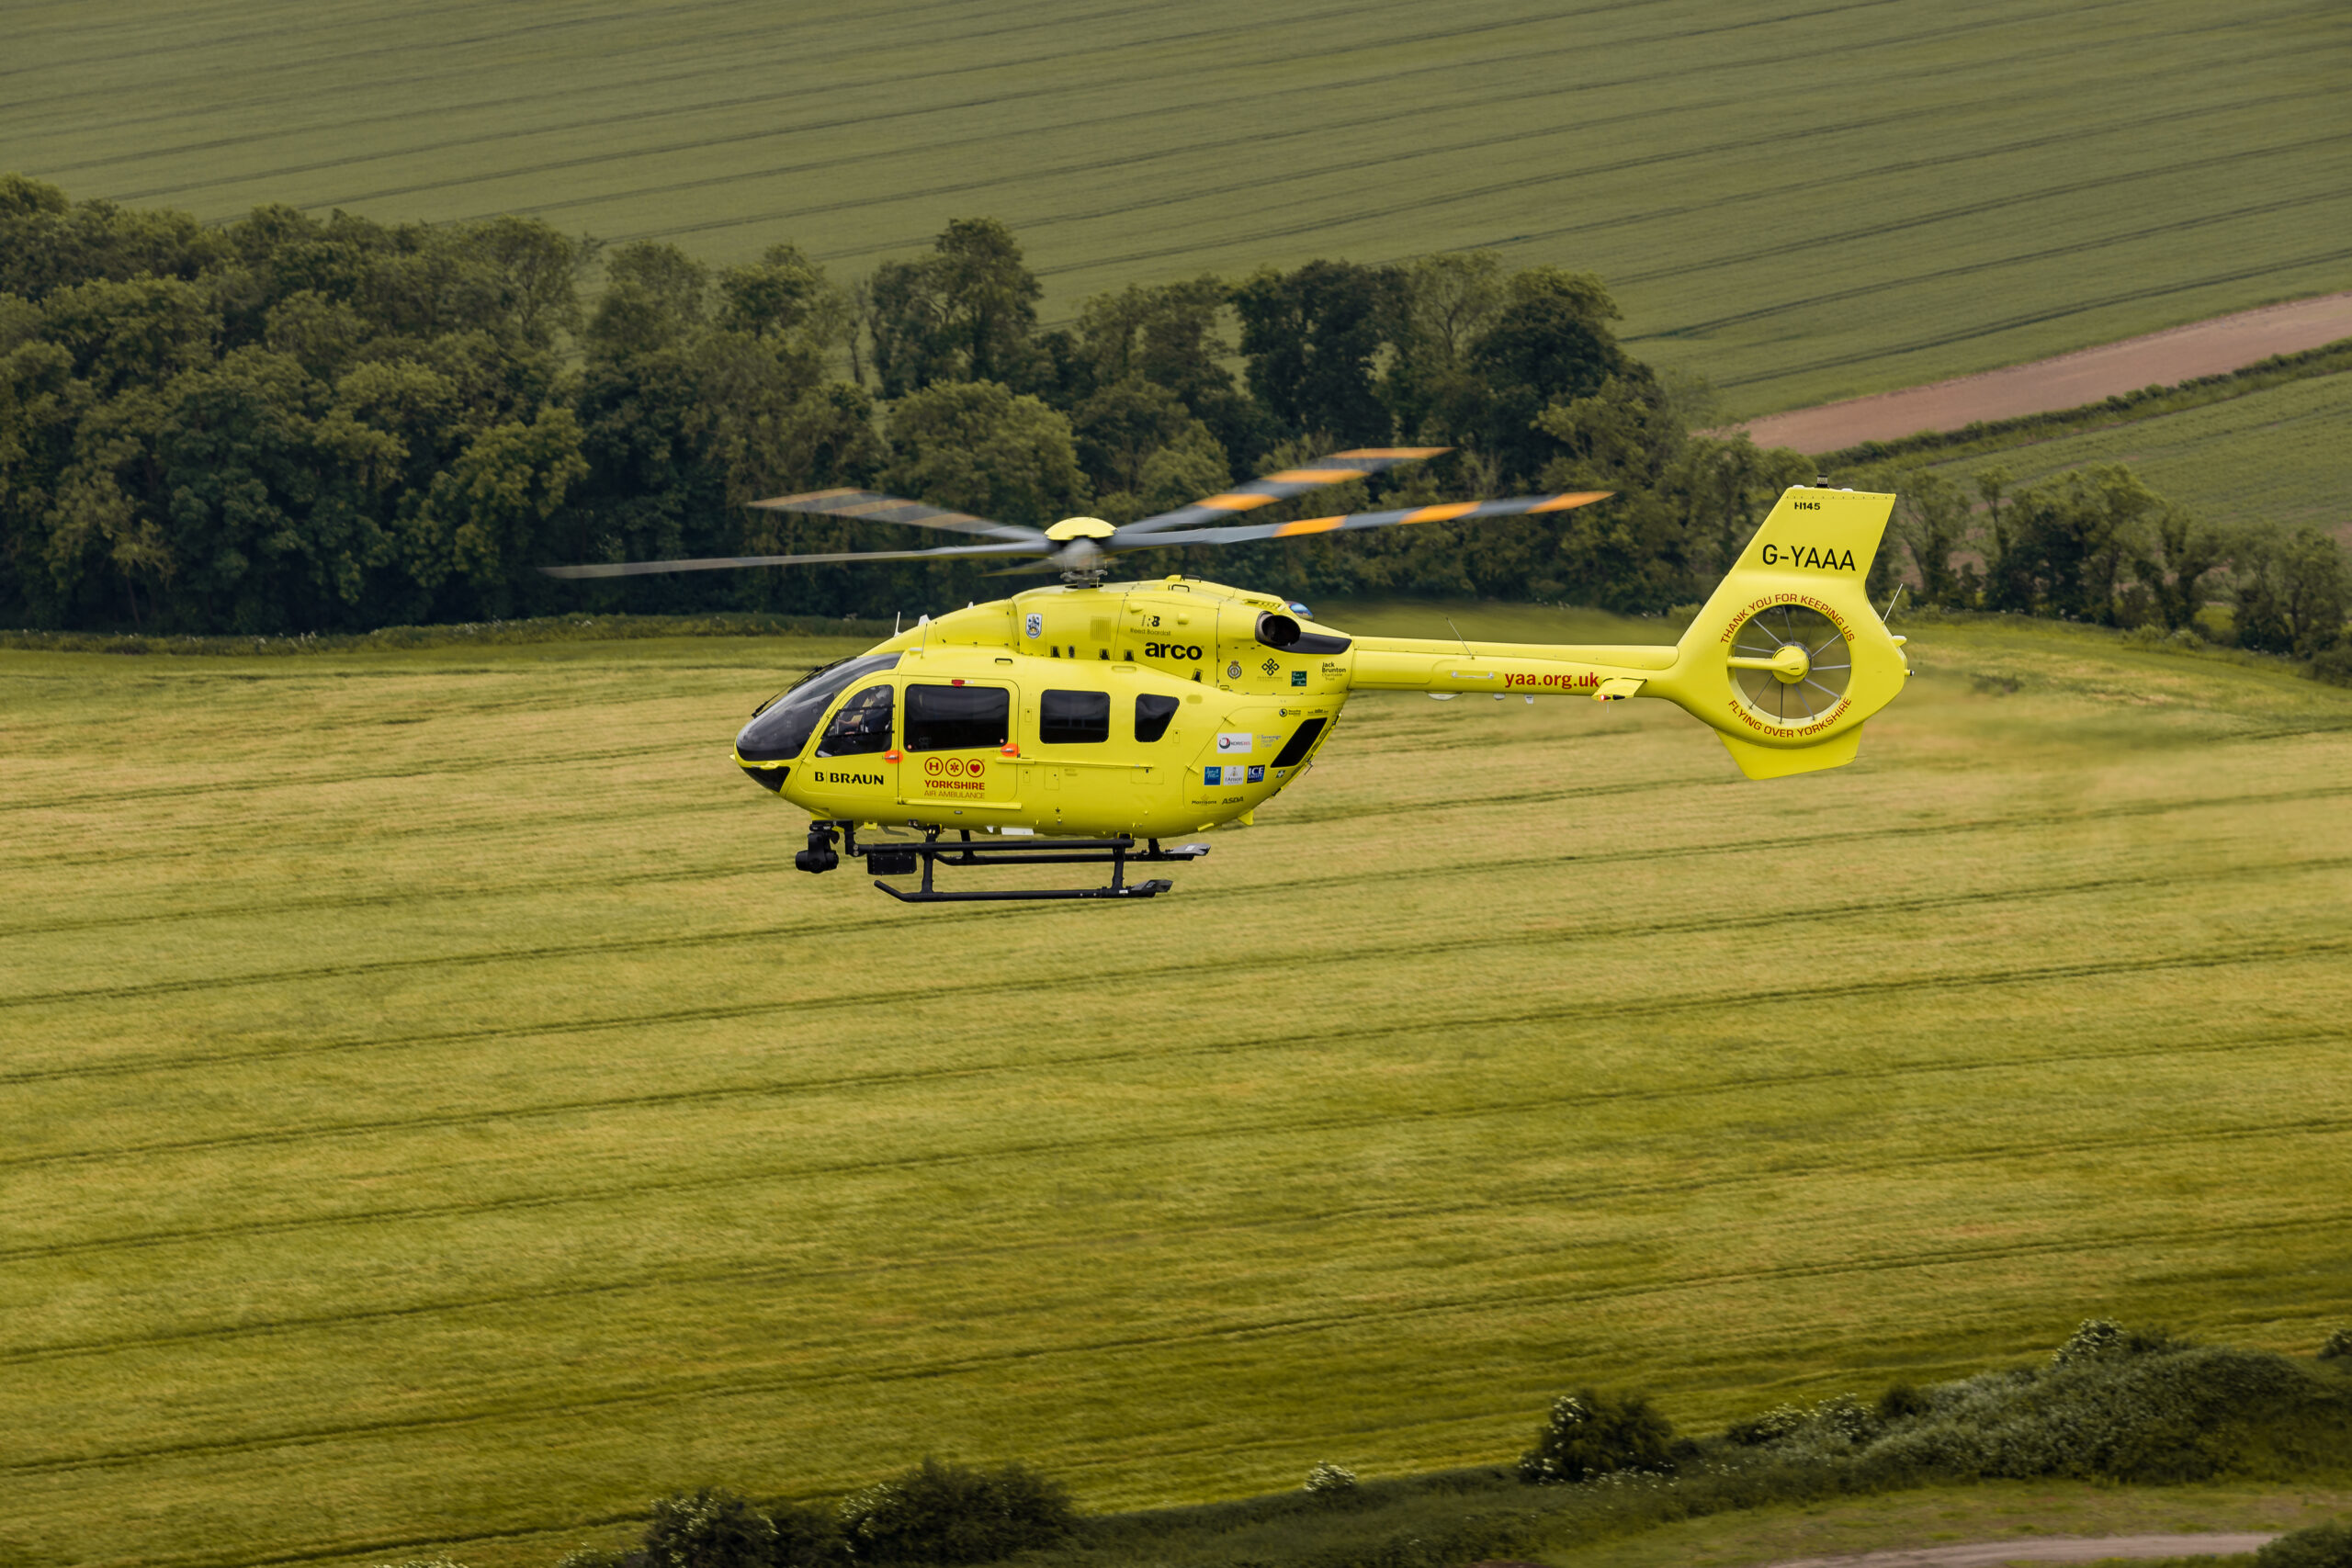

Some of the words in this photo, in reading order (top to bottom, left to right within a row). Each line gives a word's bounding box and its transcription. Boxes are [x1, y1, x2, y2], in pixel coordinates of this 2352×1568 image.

[1794, 502, 1821, 511] H145
[1762, 544, 1856, 571] G-YAAA
[1720, 609, 1749, 644] THANK
[1748, 596, 1772, 612] YOU
[1775, 593, 1798, 604] FOR
[1800, 594, 1845, 626] KEEPING
[1842, 626, 1855, 642] US
[1145, 641, 1203, 660] arco
[1504, 671, 1600, 690] yaa.org.uk
[1728, 700, 1763, 731] FLYING
[1763, 726, 1794, 738] OVER
[1797, 696, 1852, 737] YORKSHIRE
[814, 771, 825, 782] B
[830, 773, 884, 785] BRAUN
[924, 779, 985, 790] YORKSHIRE
[938, 790, 985, 799] AMBULANCE
[1222, 795, 1244, 805] ASDA
